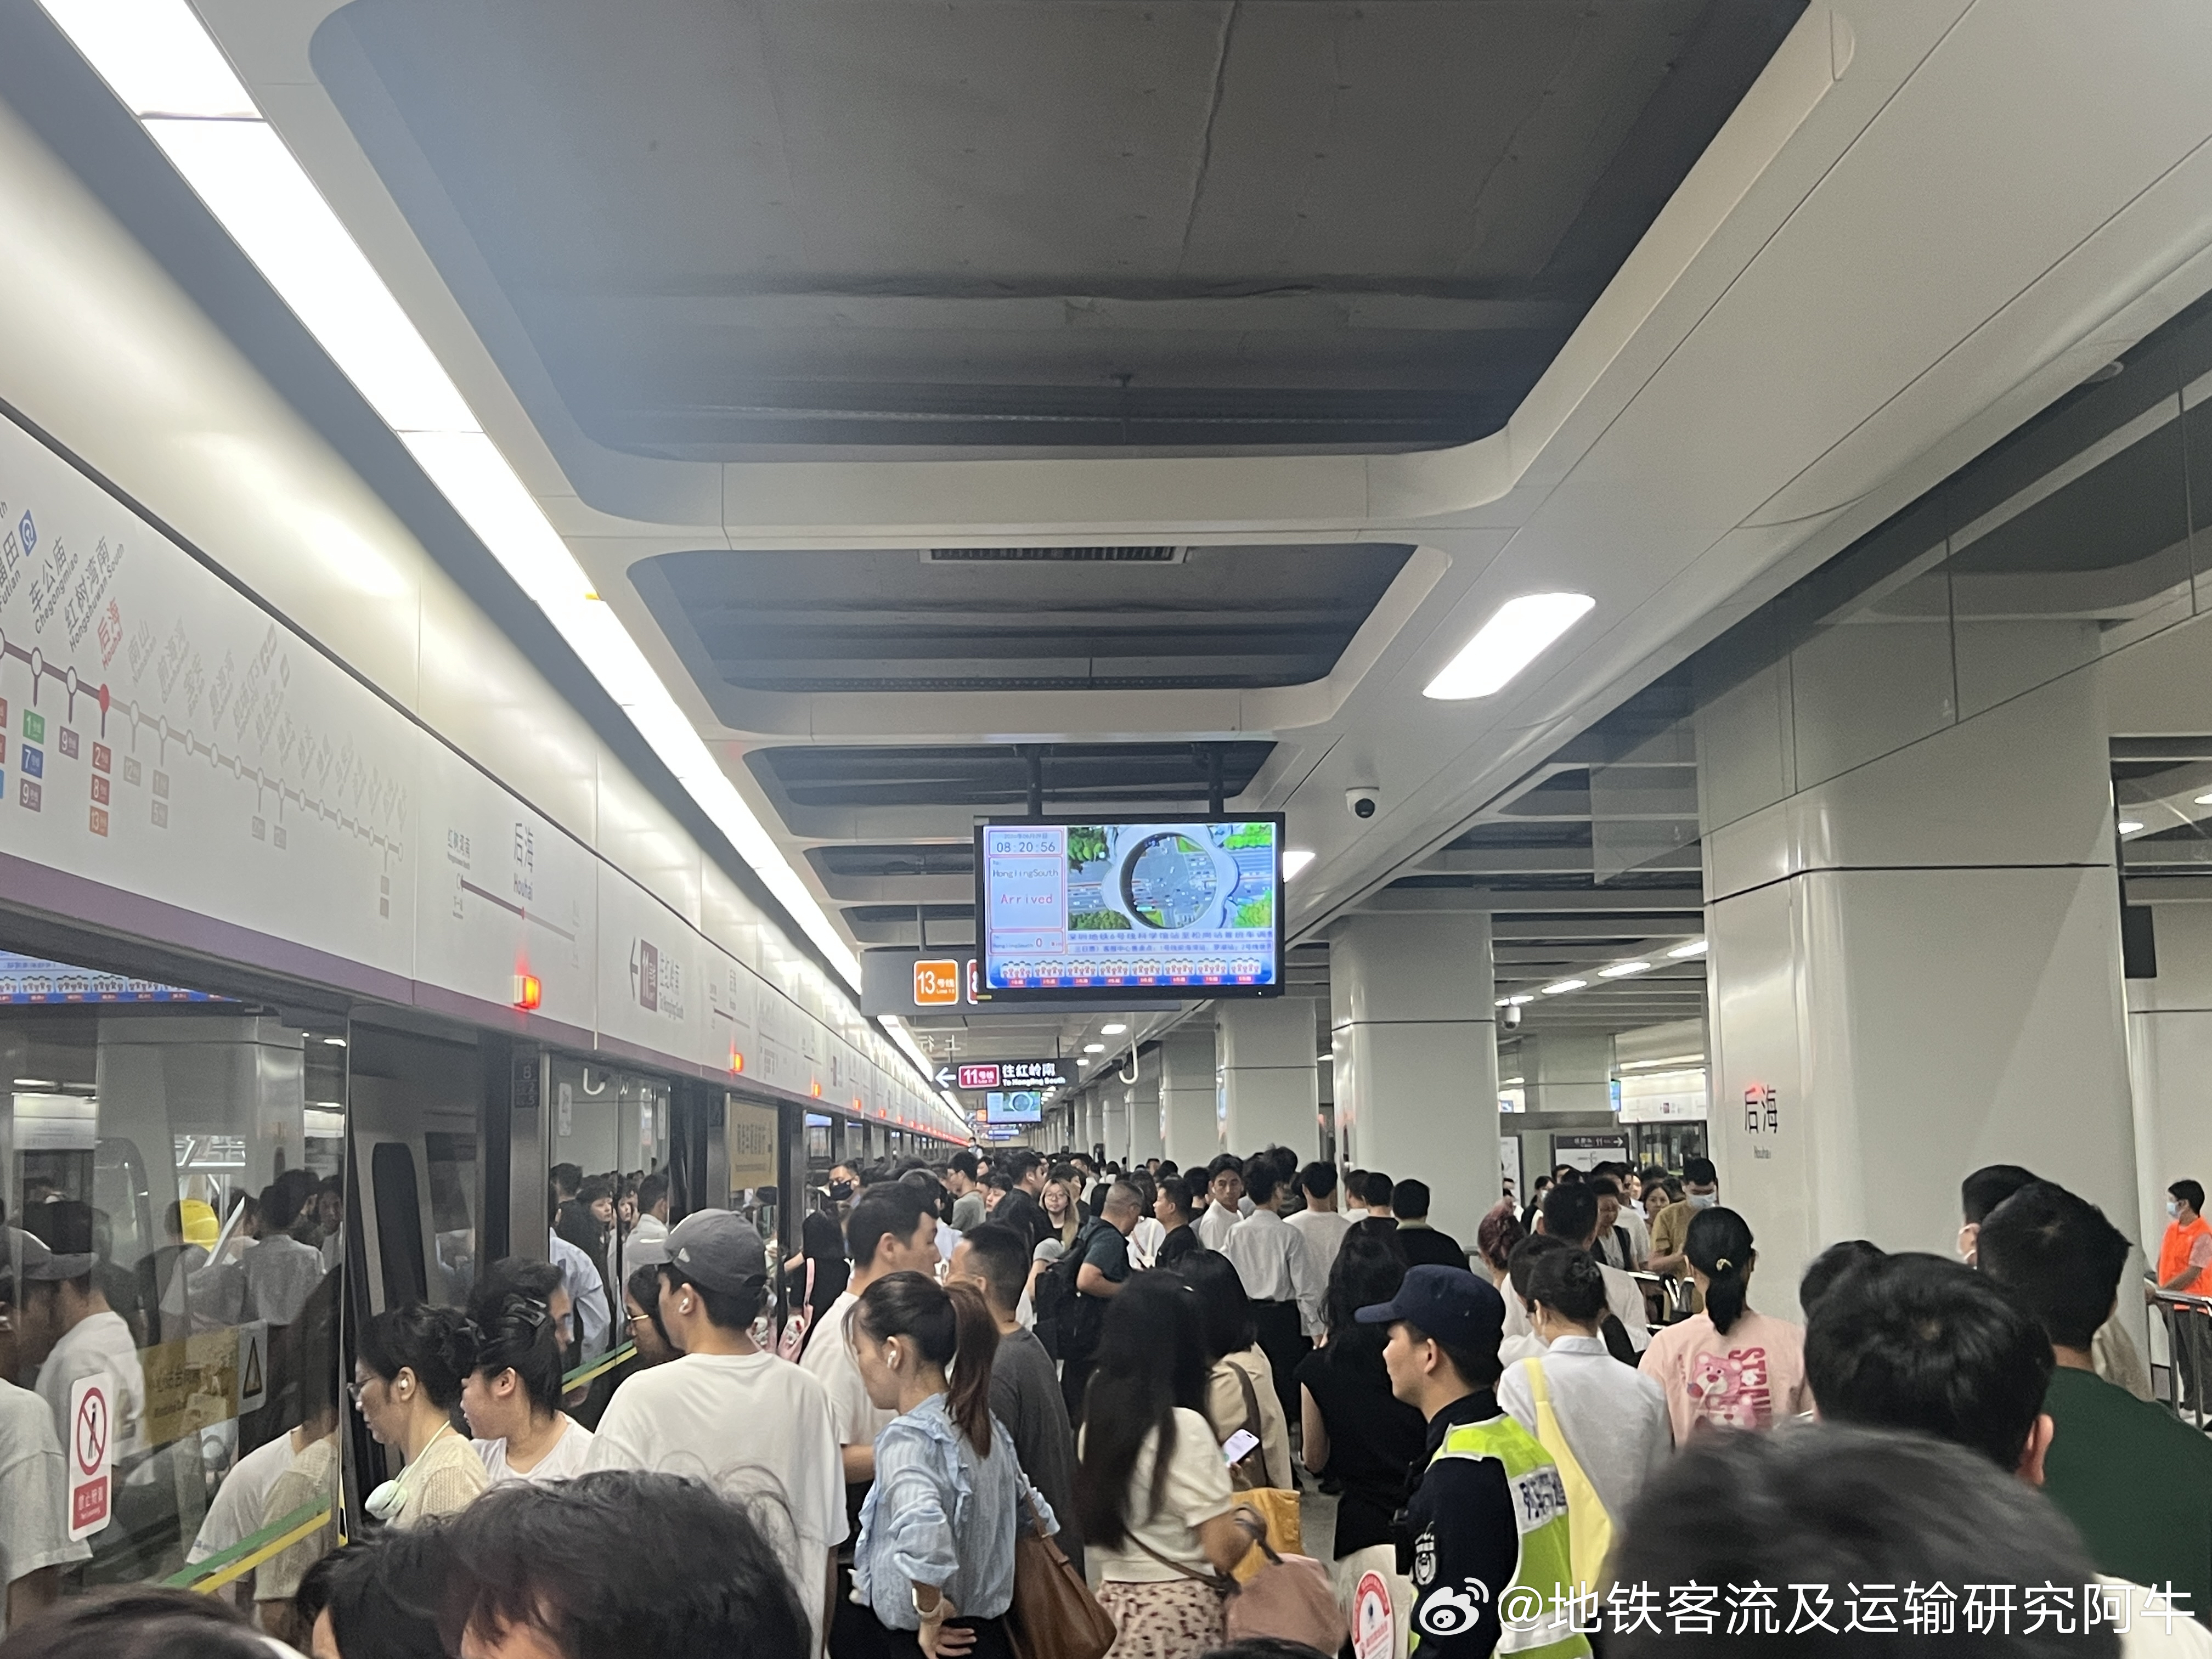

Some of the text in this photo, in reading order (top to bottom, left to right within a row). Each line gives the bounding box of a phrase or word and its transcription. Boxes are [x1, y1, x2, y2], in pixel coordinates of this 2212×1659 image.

[29, 535, 66, 613] 车公庙
[35, 553, 78, 634] Chegongmiao
[64, 535, 110, 635] 红树湾南
[69, 543, 124, 653] Hongshuwan South
[98, 597, 123, 653] 后海
[61, 731, 67, 751] 9
[25, 749, 31, 769] 7
[94, 747, 100, 765] 2
[22, 783, 29, 804] 9
[93, 778, 100, 798] 8
[91, 810, 100, 831] 13
[514, 823, 534, 873] 后海
[997, 842, 1056, 853] 08:20:56
[992, 868, 1059, 878] HonglingSouth
[1001, 893, 1053, 904] Arrived
[917, 970, 935, 994] 13
[963, 1069, 978, 1085] 11
[1002, 1063, 1056, 1077] 往红岭南
[1744, 1084, 1778, 1134] 后海
